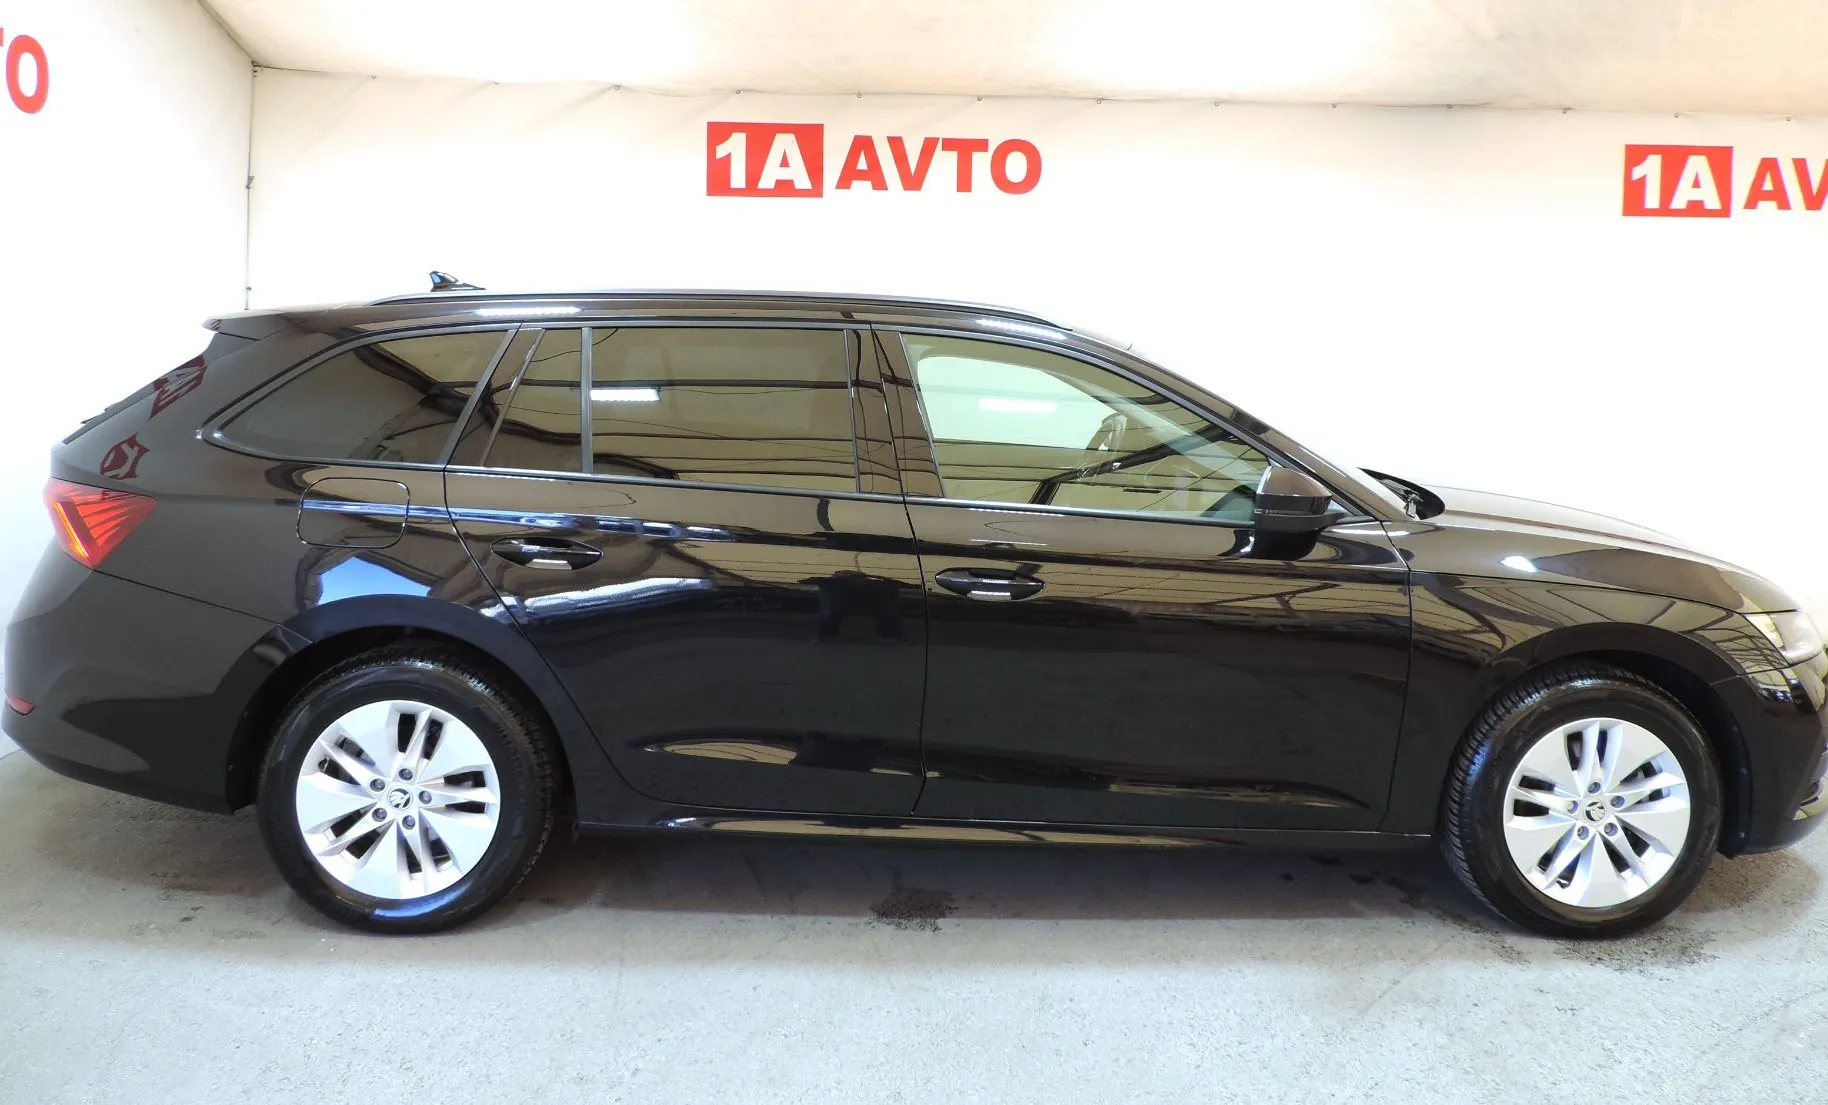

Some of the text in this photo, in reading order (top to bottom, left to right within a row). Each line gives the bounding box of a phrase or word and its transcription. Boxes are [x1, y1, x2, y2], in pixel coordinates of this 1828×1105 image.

[0, 27, 49, 114] O
[715, 132, 1043, 195] 1A AVTO
[1632, 154, 1722, 210] 1A
